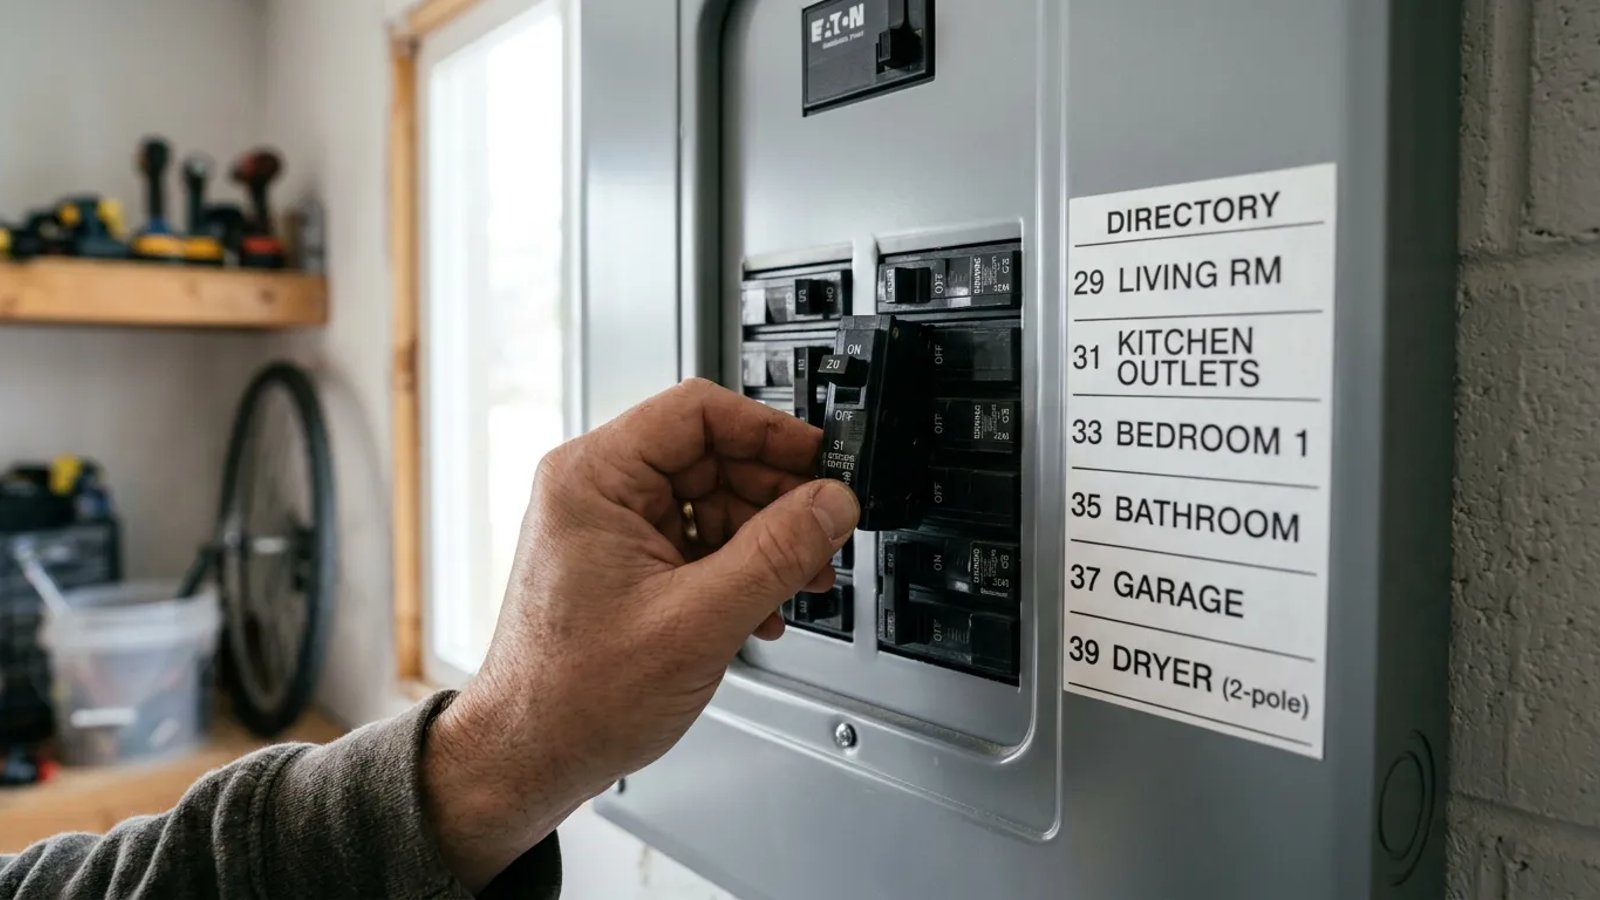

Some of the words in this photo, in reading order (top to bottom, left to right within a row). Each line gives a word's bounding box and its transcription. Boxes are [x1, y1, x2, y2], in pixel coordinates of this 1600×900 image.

[1107, 191, 1280, 235] DIRECTORY
[1073, 269, 1104, 296] 29
[1119, 260, 1217, 293] LIVING
[1230, 255, 1281, 287] RM
[847, 343, 862, 356] ON
[934, 344, 944, 365] OFF
[1118, 326, 1253, 356] KITCHEN
[1072, 344, 1100, 370] 31
[1117, 359, 1260, 388] OUTLETS
[1072, 418, 1103, 445] 33
[1116, 420, 1280, 456] BEDROOM
[1295, 429, 1308, 458] 1
[934, 482, 943, 504] OFF
[1071, 491, 1102, 519] 35
[1115, 495, 1300, 543] BATHROOM
[933, 554, 943, 572] ON
[1070, 563, 1101, 592] 37
[1113, 570, 1245, 619] GARAGE
[1068, 635, 1100, 666] 39
[1112, 644, 1213, 693] DRYER
[1222, 676, 1310, 720] (2-pole)
